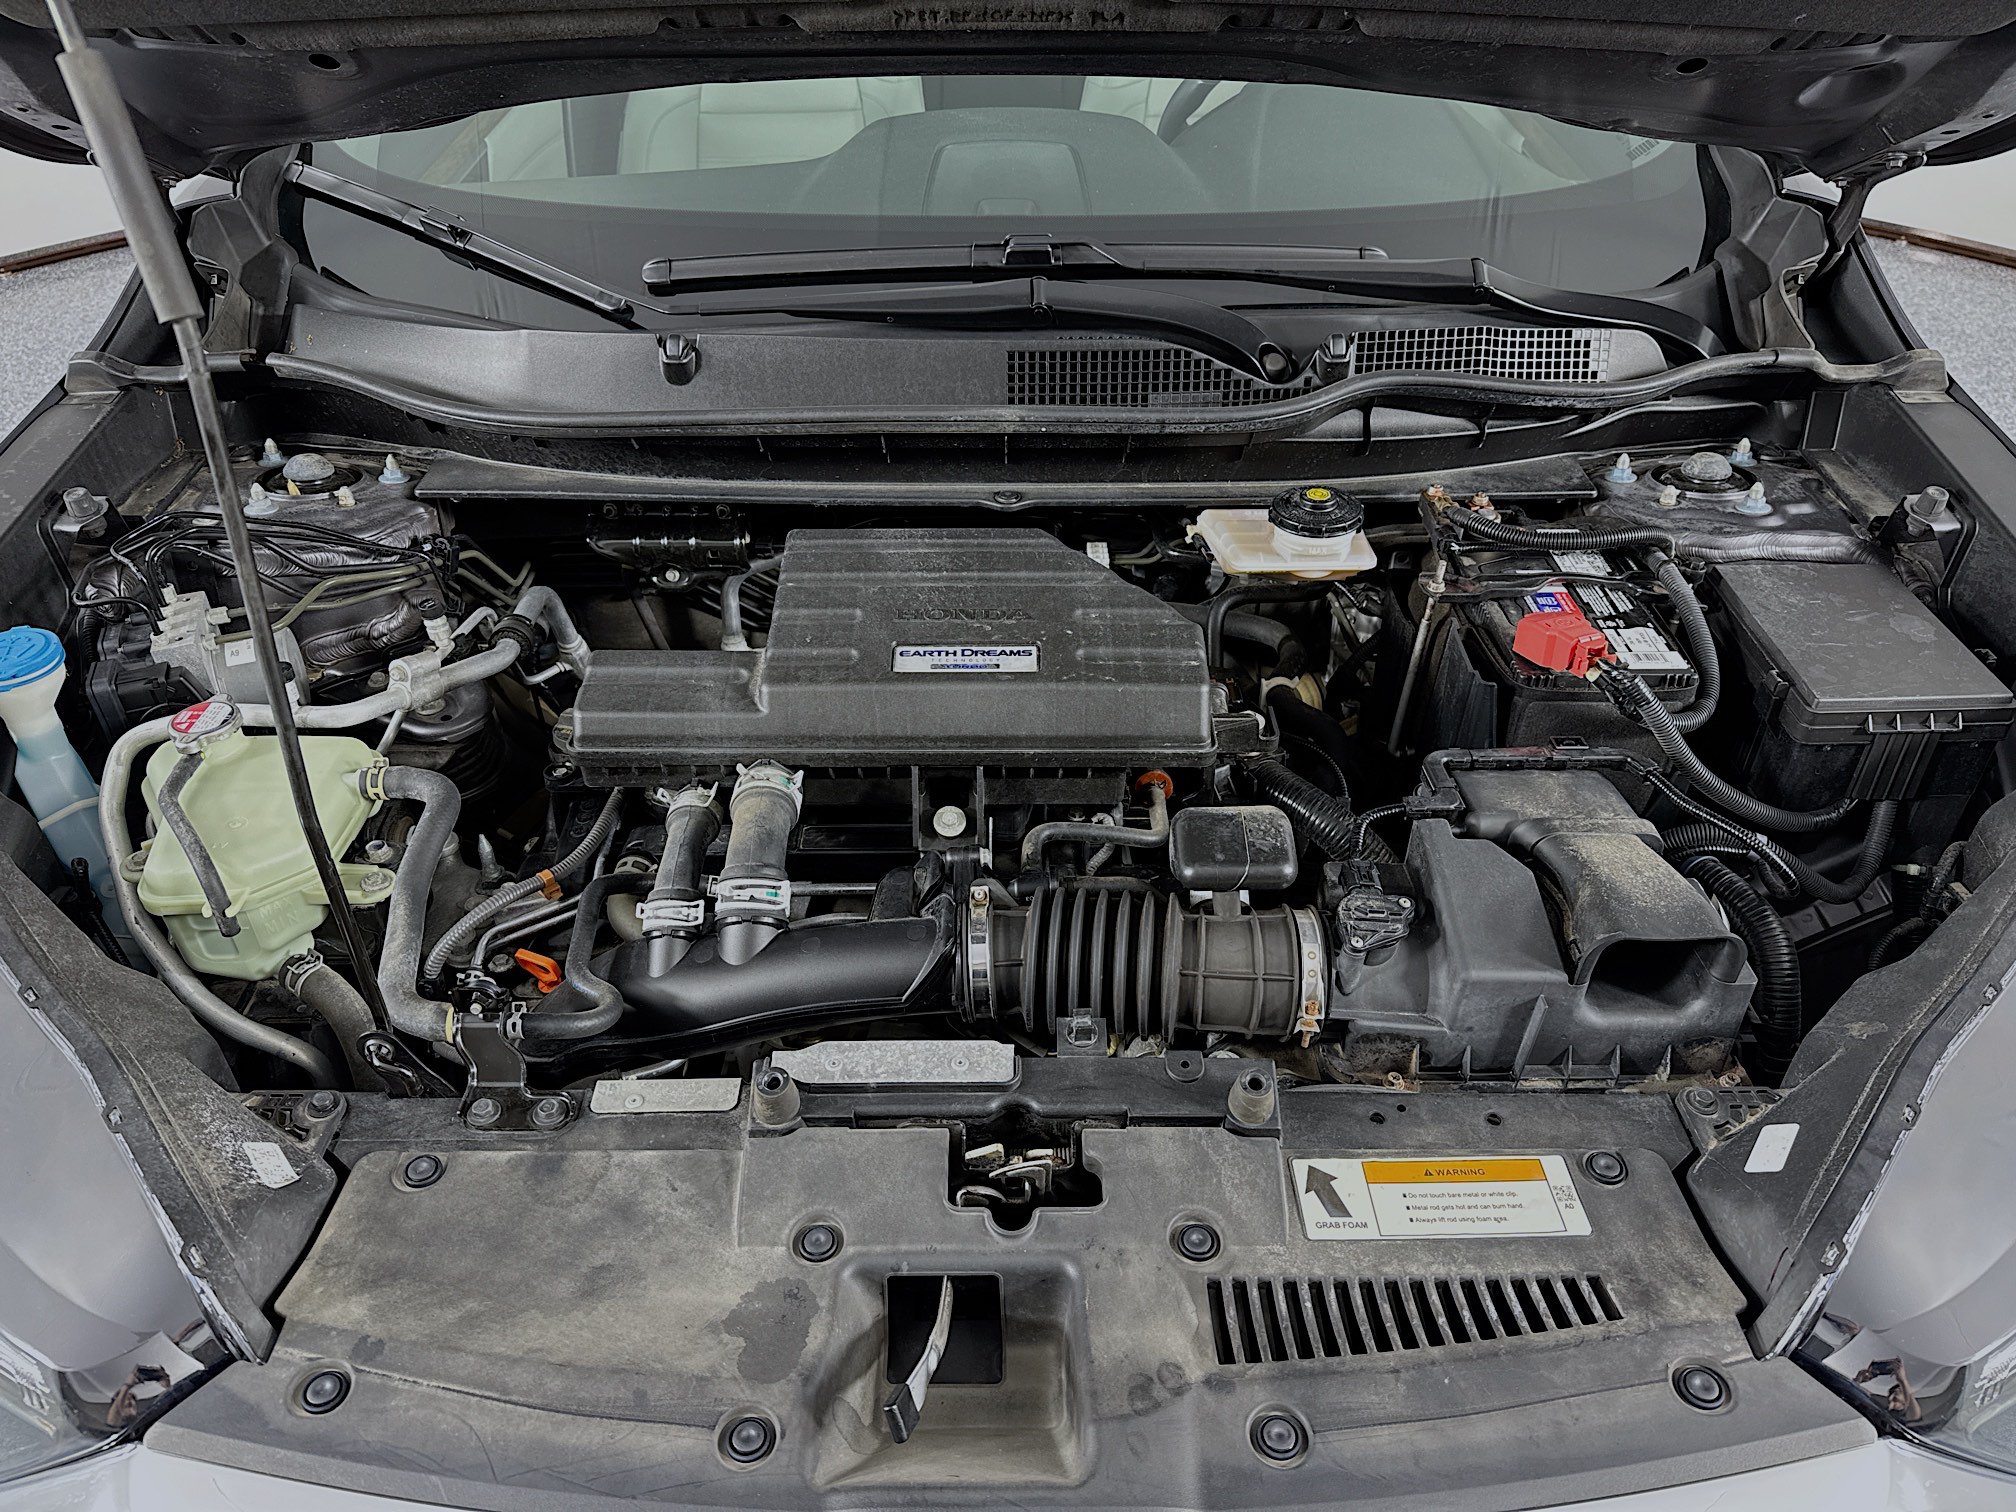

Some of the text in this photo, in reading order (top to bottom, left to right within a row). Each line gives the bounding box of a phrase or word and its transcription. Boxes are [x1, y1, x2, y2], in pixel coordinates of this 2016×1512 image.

[893, 609, 1038, 621] HONDA
[230, 649, 240, 657] A9
[960, 649, 1033, 657] DREAMS
[1435, 1168, 1486, 1176] WARNING
[1505, 1190, 1518, 1198] clip.
[1441, 1204, 1454, 1212] gets
[1415, 1216, 1437, 1225] Always
[1315, 1221, 1369, 1229] GRAB FOAM
